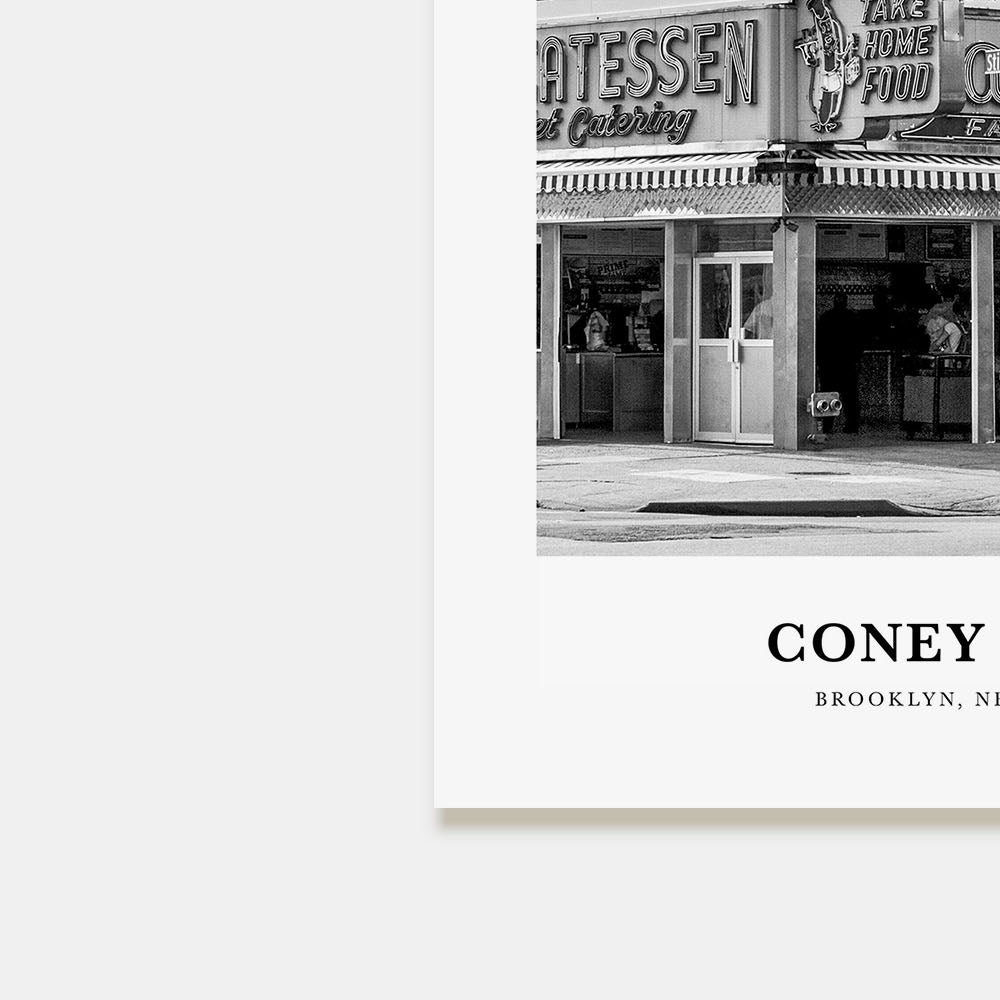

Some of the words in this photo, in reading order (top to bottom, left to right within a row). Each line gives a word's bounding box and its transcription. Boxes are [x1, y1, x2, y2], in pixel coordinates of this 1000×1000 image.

[539, 20, 758, 106] ATESSEN
[862, 25, 936, 59] HOME
[860, 62, 932, 105] FOOD
[568, 101, 698, 147] Catering
[767, 622, 985, 663] CONEY
[815, 691, 963, 710] BROOKLYN,
